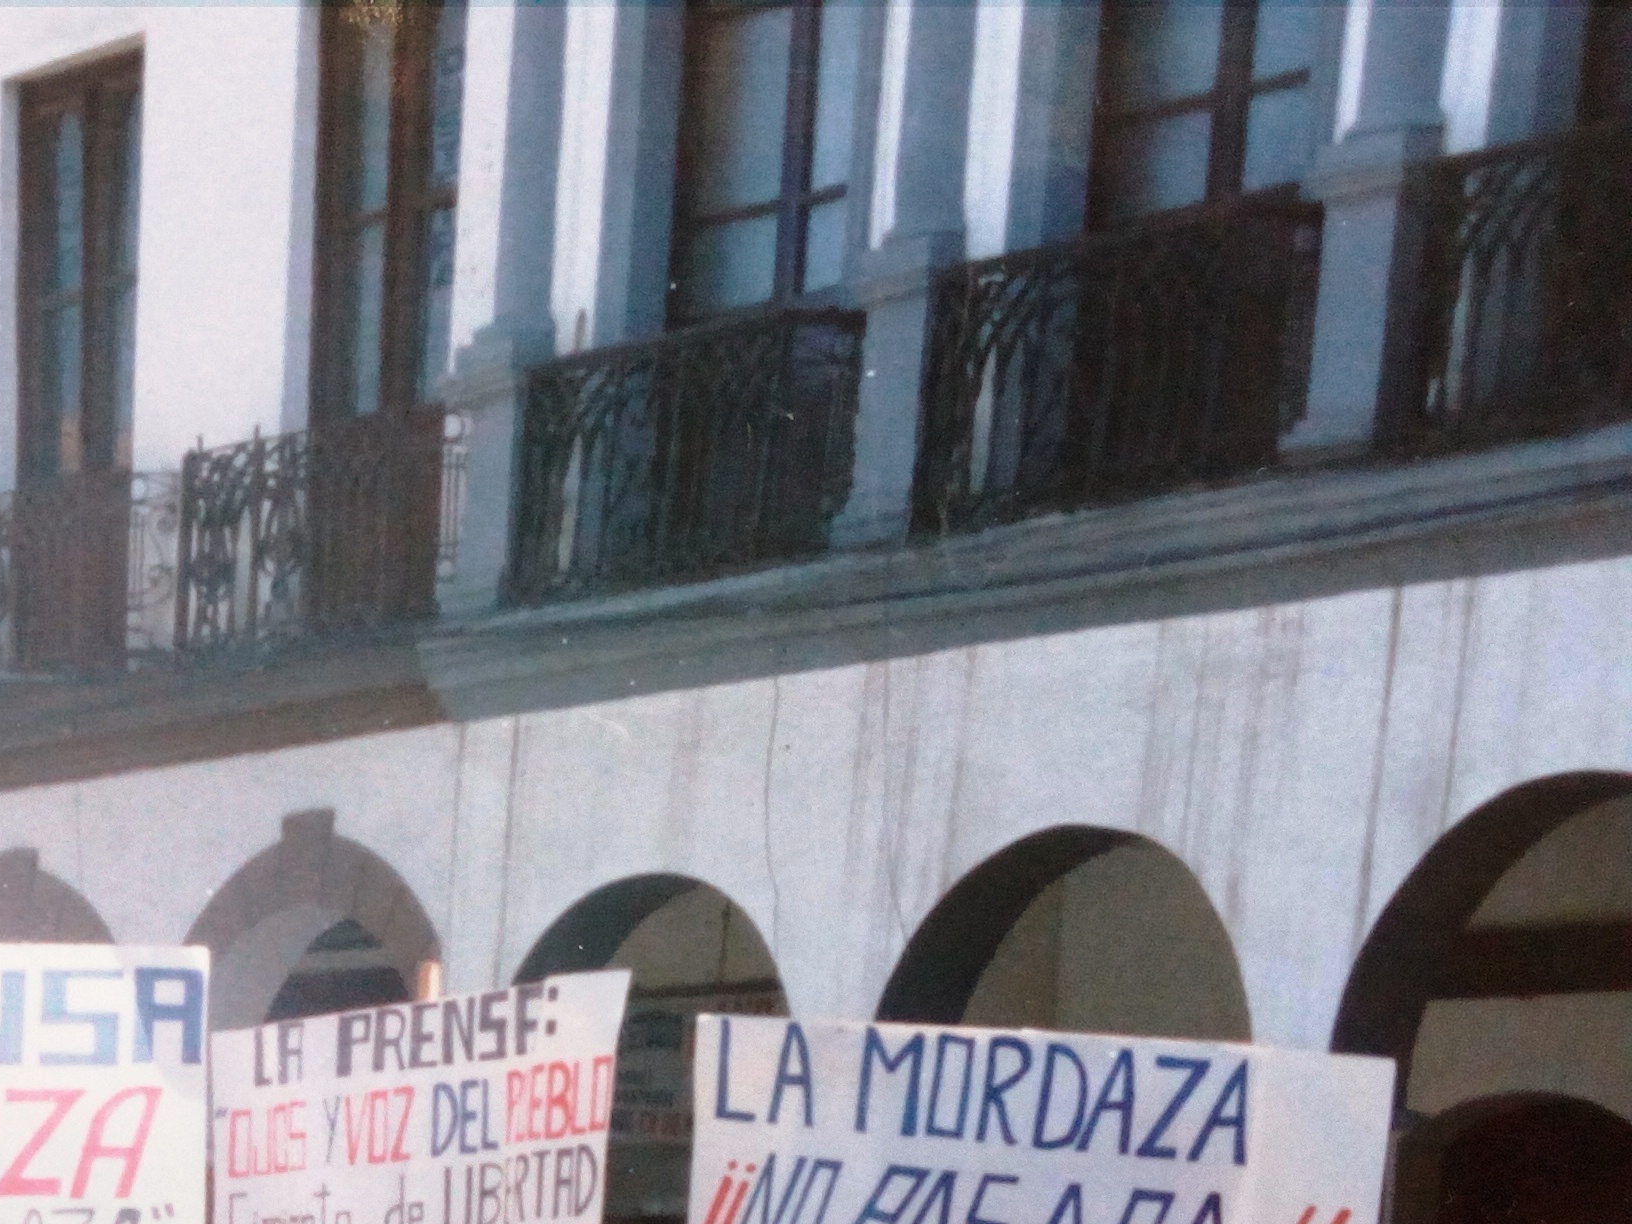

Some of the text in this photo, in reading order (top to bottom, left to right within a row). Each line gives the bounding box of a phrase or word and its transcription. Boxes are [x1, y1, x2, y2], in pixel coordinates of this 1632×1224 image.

[254, 1021, 304, 1087] LA
[713, 1016, 1251, 1167] LA MORDAZA
[321, 1094, 342, 1164] Y
[343, 1083, 416, 1167] VOZ
[429, 1078, 499, 1159] DEL
